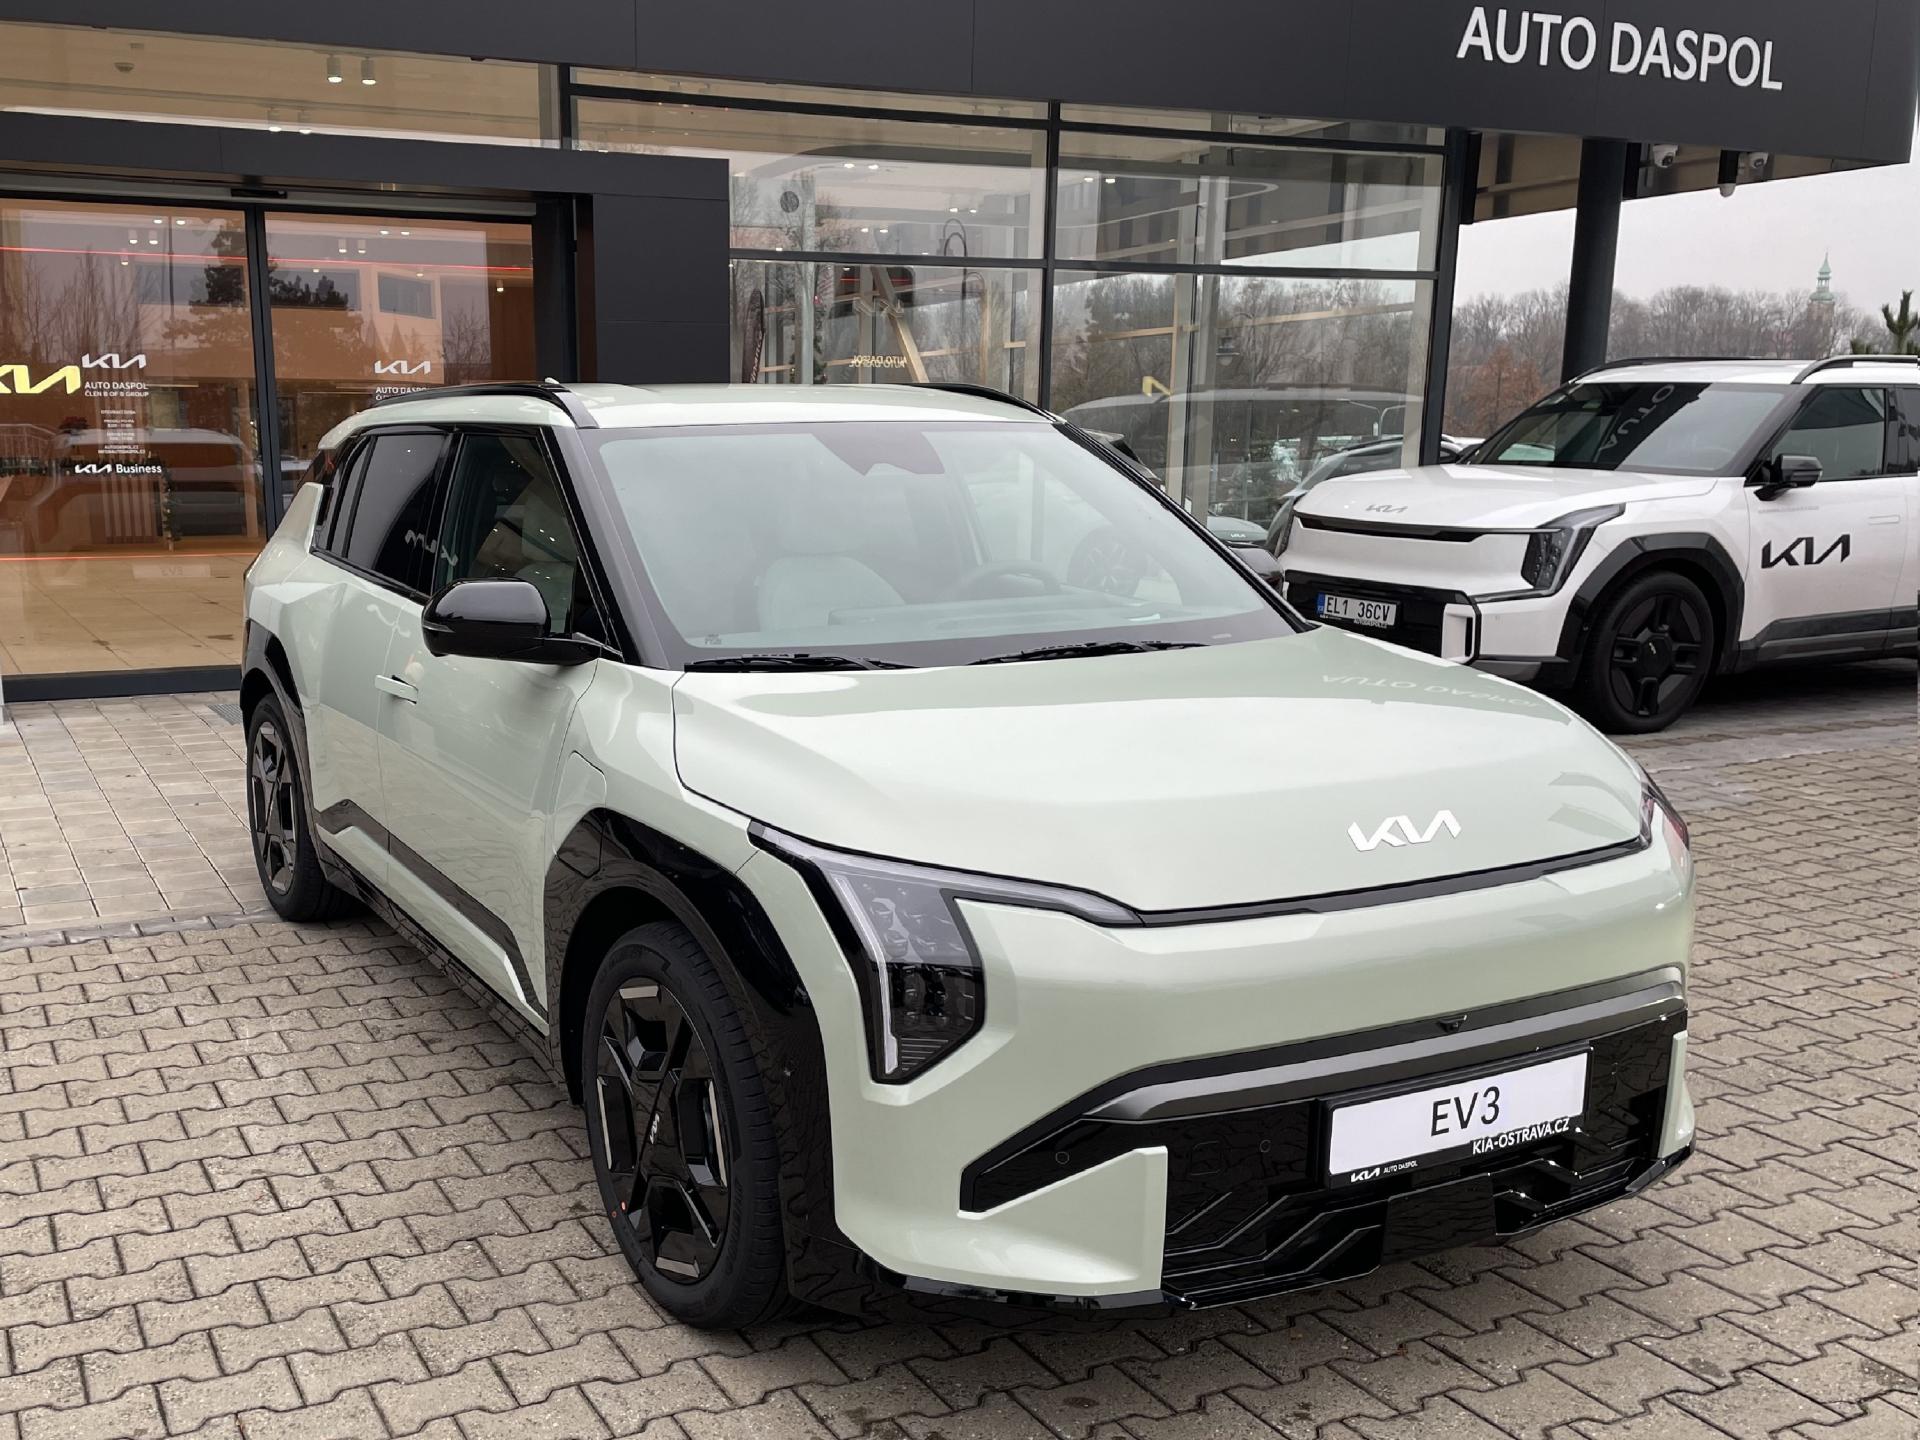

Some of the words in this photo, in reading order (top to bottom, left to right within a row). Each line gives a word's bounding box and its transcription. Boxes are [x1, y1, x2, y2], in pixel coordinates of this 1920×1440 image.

[1456, 6, 1597, 71] AUTO
[1609, 21, 1783, 91] DASPOL
[81, 353, 147, 369] KIA
[373, 360, 431, 375] KIA
[0, 364, 81, 394] IA
[84, 381, 113, 390] AUTO
[112, 382, 149, 390] DASPOL
[375, 386, 399, 394] AUTO
[74, 464, 113, 474] KIA
[116, 464, 162, 474] Business
[1761, 533, 1850, 569] KIA
[1326, 597, 1349, 616] EL1
[1358, 602, 1390, 622] 36CV
[1347, 809, 1462, 852] KIA
[1430, 1085, 1501, 1137] EV3
[1471, 1117, 1570, 1156] KIA-OSTRAVA.CZ
[1350, 1167, 1381, 1183] KIA
[1383, 1164, 1398, 1174] AUTO
[1398, 1160, 1418, 1170] DASPOL
